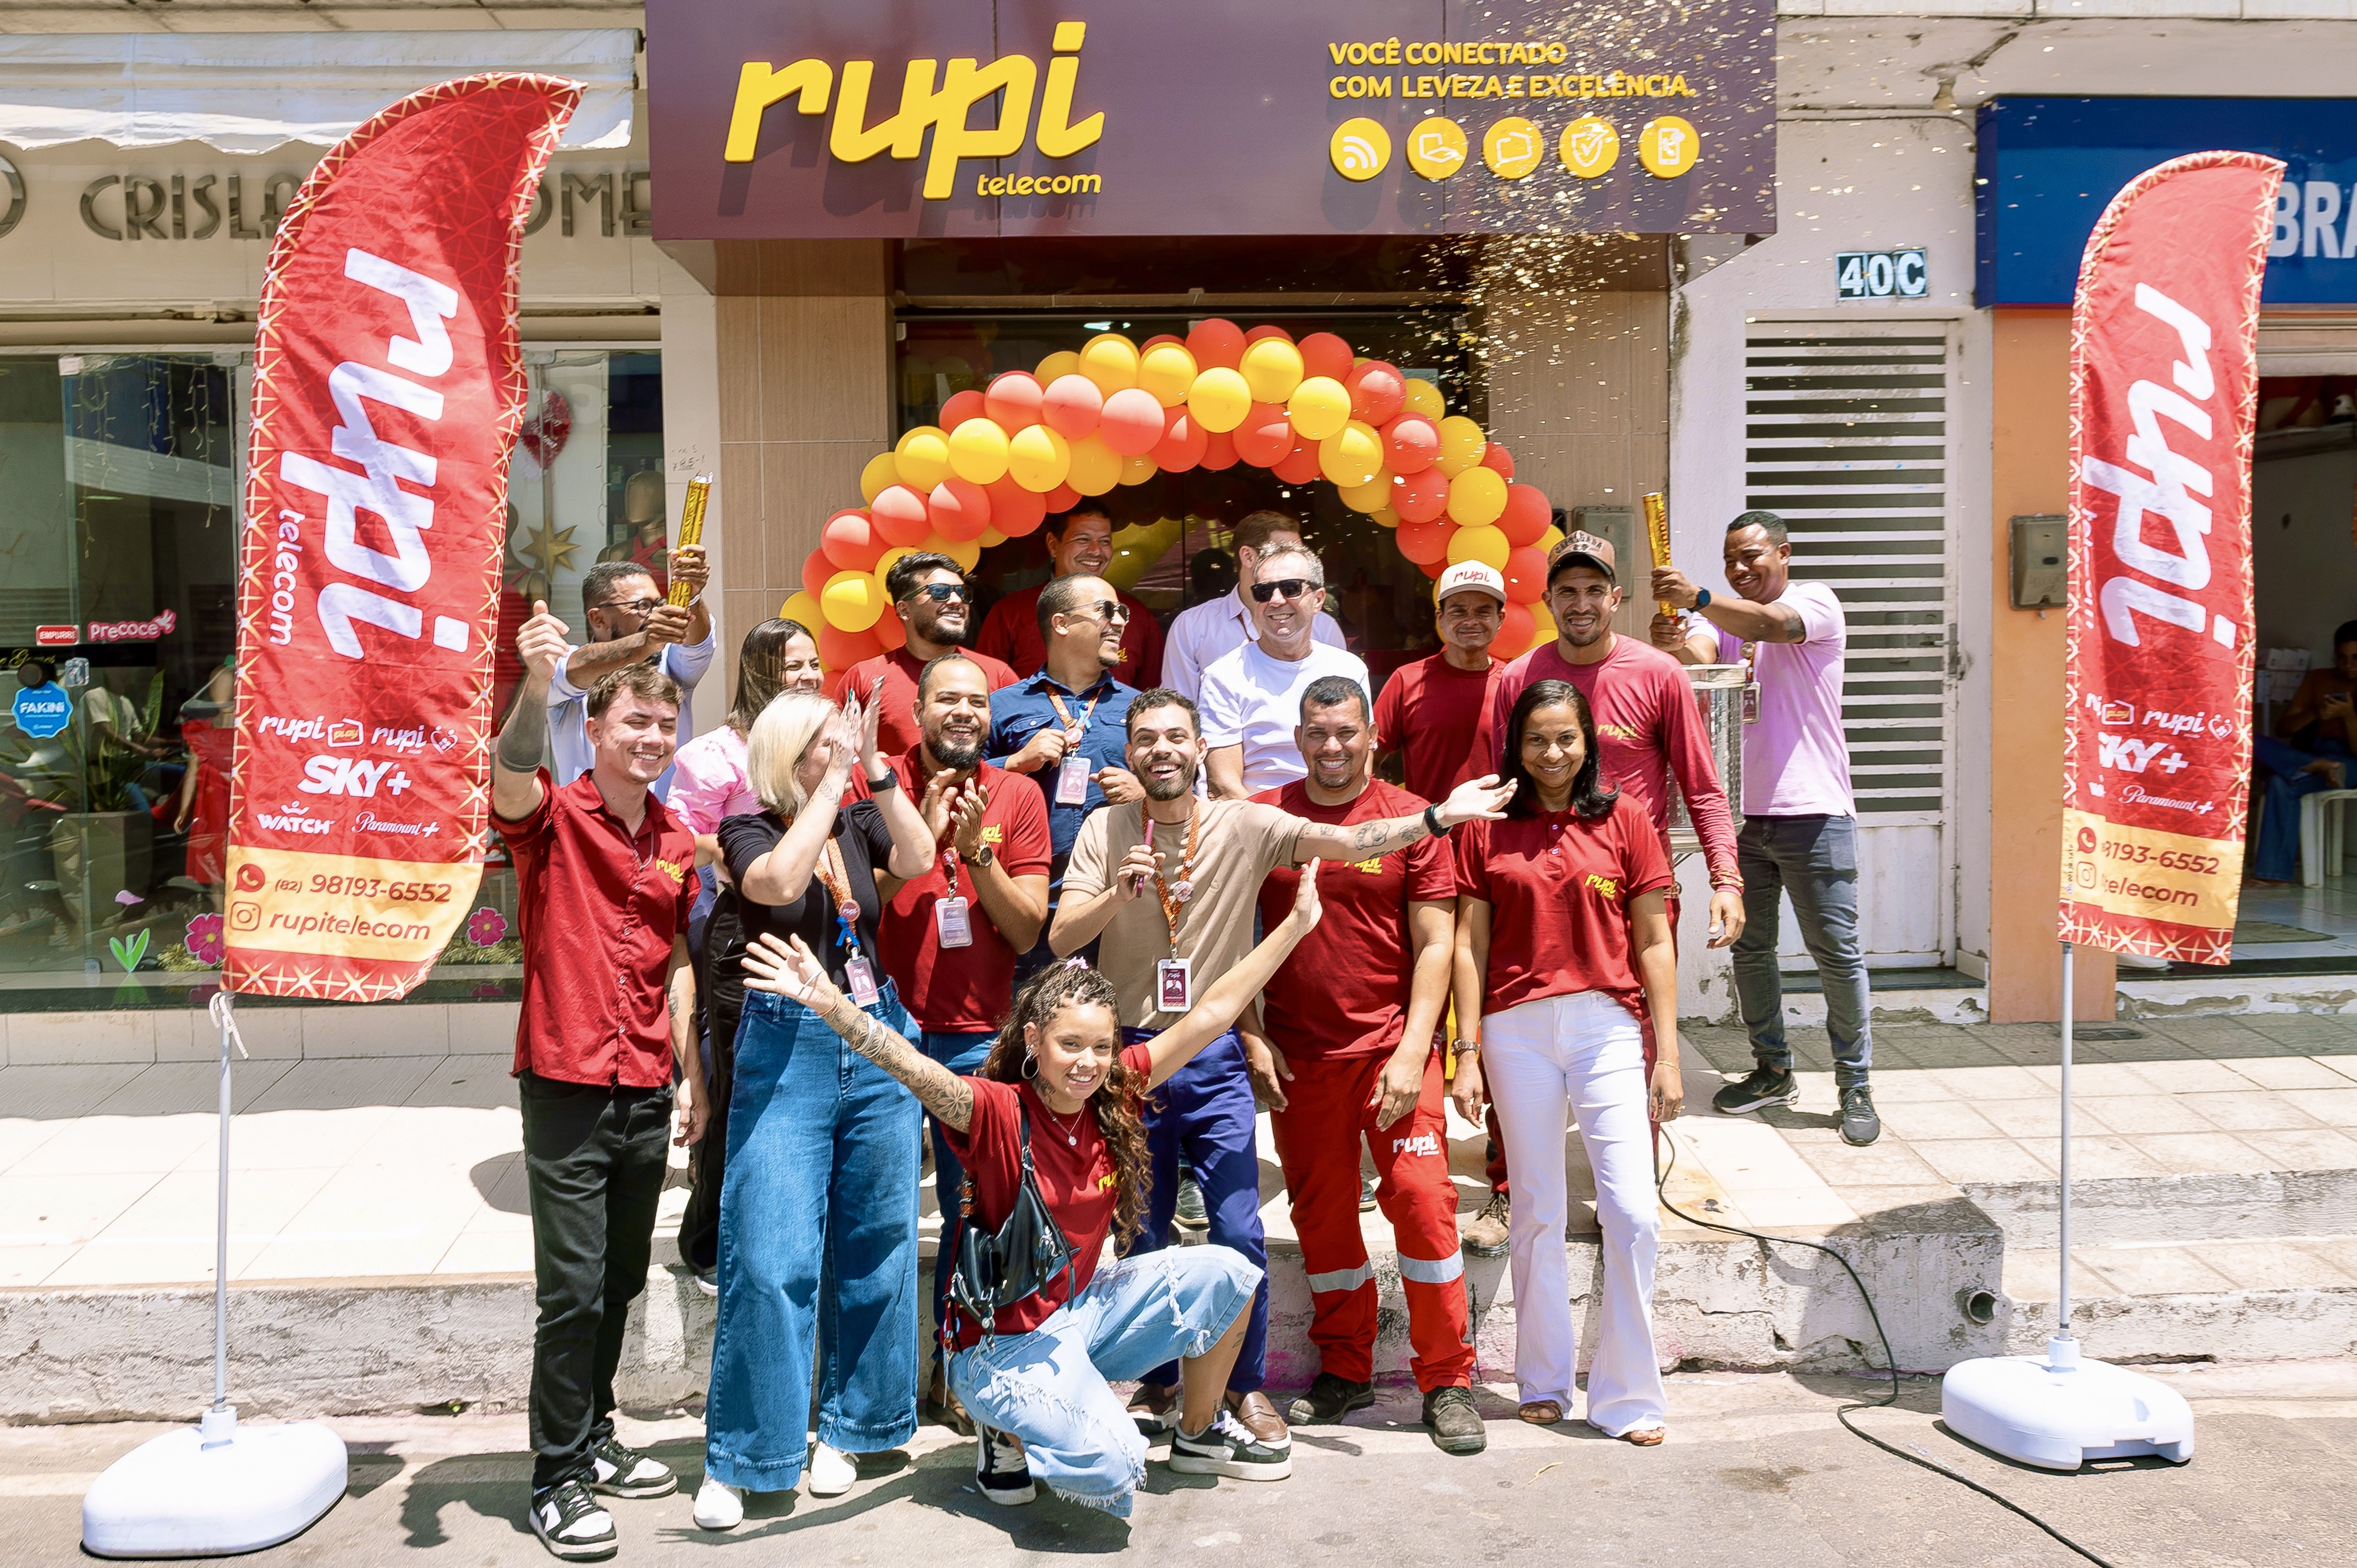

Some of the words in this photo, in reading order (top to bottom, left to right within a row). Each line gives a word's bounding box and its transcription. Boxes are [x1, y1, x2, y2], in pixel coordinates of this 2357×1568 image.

[1328, 37, 1401, 65] VOCÊ
[1405, 42, 1567, 65] CONECTADO
[1329, 75, 1392, 98] COM
[1402, 75, 1502, 98] LEVEZA
[1507, 75, 1525, 98] E
[1529, 69, 1696, 98] EXCELÊNCIA.
[724, 21, 1105, 200] rupi
[977, 173, 1102, 197] telecom
[1840, 252, 1926, 295] 40C
[280, 248, 469, 659] rupi
[2081, 282, 2237, 650] rupi
[270, 508, 304, 645] telecom
[1453, 571, 1490, 582] rupi
[258, 715, 326, 744] rupi
[2141, 710, 2205, 735] rupi
[371, 724, 427, 754] rupi
[256, 813, 332, 835] WATCH
[275, 879, 303, 894] (82)
[310, 874, 452, 903] 98193-6552
[1585, 874, 1618, 895] rupi
[269, 911, 431, 940] rupitelecom
[1392, 1131, 1438, 1157] rupi
